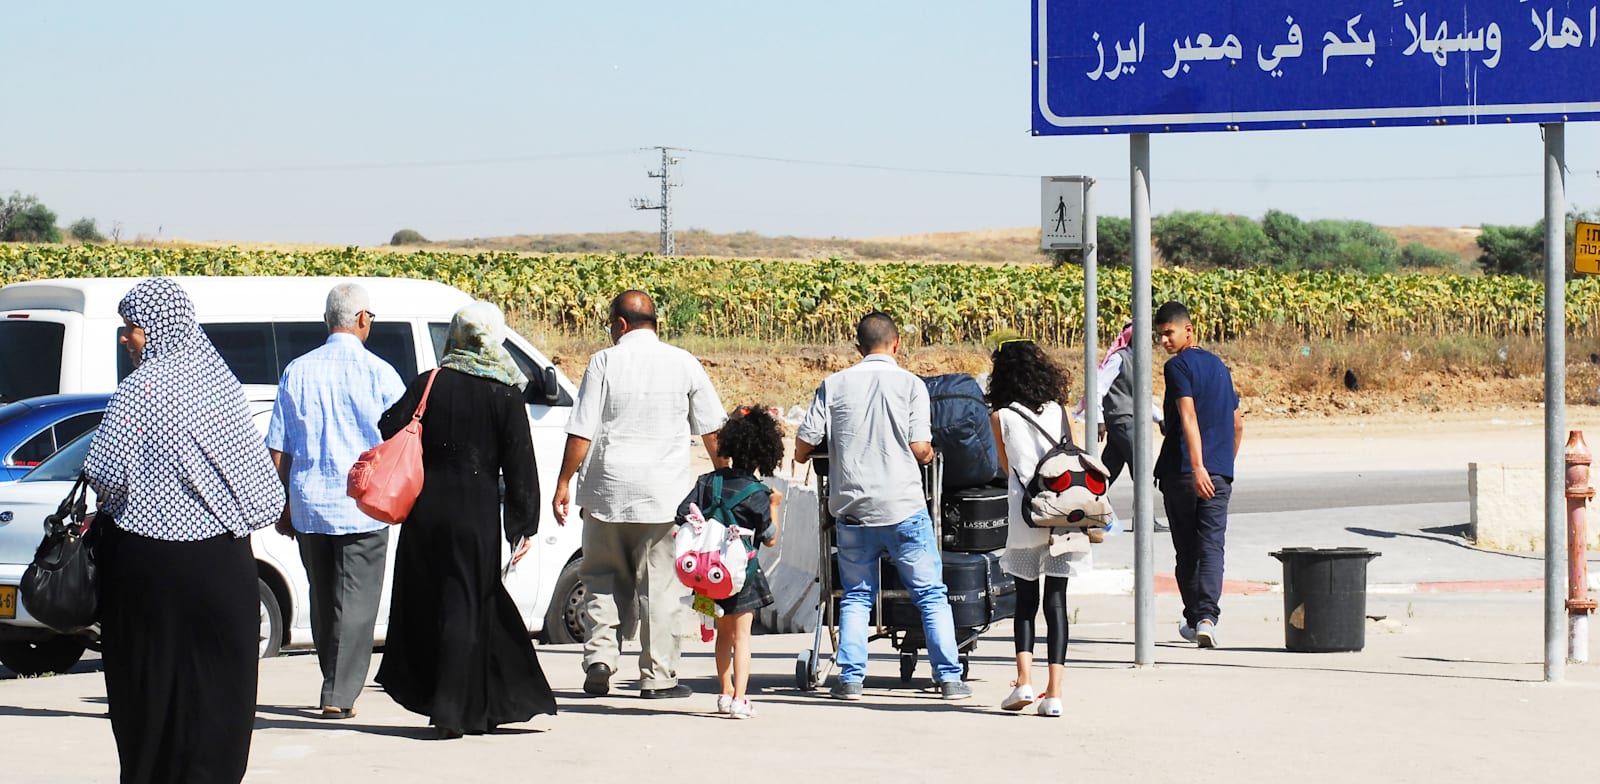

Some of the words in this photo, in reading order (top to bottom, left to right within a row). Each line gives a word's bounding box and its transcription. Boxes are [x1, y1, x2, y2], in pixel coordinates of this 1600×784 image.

[1086, 22, 1145, 80] ايرز
[1162, 33, 1243, 78] معبر
[1257, 15, 1303, 77] في
[1322, 13, 1376, 75] بكم
